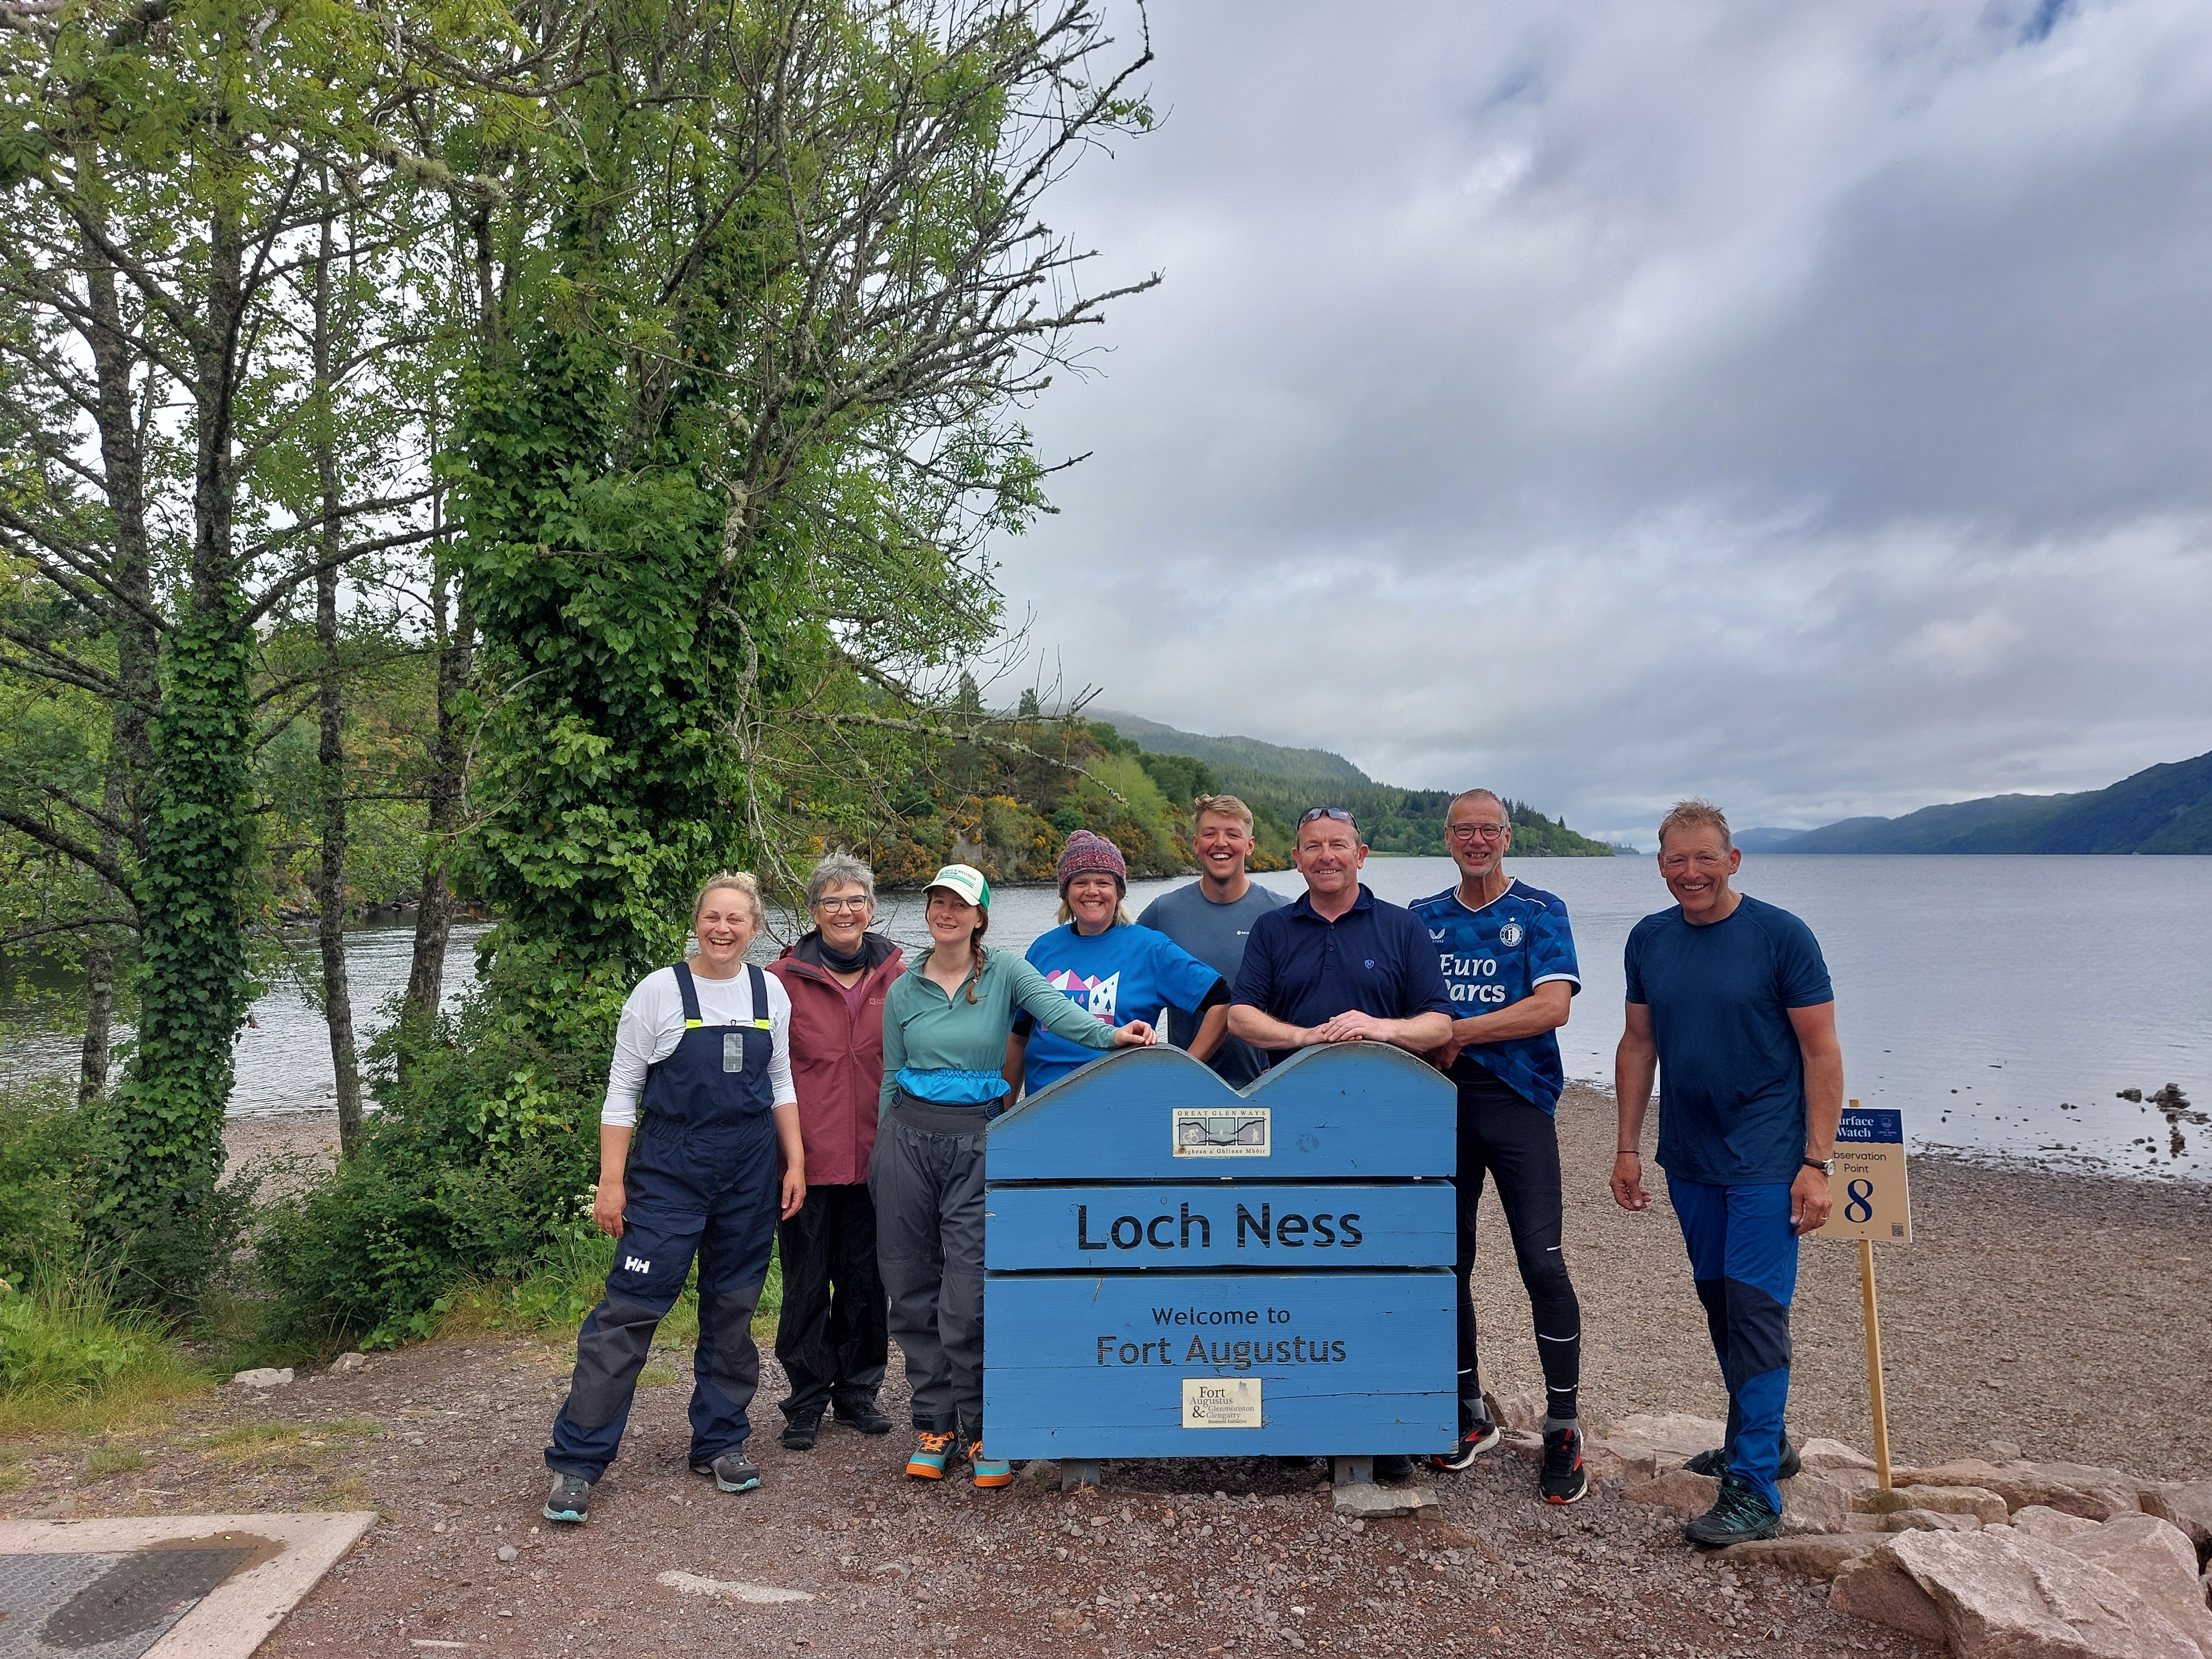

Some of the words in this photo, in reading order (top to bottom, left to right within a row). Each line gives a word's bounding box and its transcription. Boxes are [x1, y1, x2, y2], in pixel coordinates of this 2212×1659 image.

[1440, 954, 1496, 976] Euro
[1839, 1116, 1874, 1126] urface
[1833, 1150, 1886, 1161] bservation
[1844, 1163, 1869, 1173] Point
[1845, 1179, 1873, 1223] 8
[1078, 1202, 1210, 1250] Loch
[1237, 1203, 1363, 1249] Ness
[1151, 1306, 1258, 1326] Welcome
[1267, 1307, 1290, 1324] to
[1097, 1336, 1172, 1365] Fort
[1185, 1335, 1347, 1370] Augustus
[1199, 1387, 1226, 1398] Fort
[1190, 1396, 1233, 1407] Augustus
[1193, 1405, 1205, 1418] &
[1206, 1412, 1241, 1420] Glengarry
